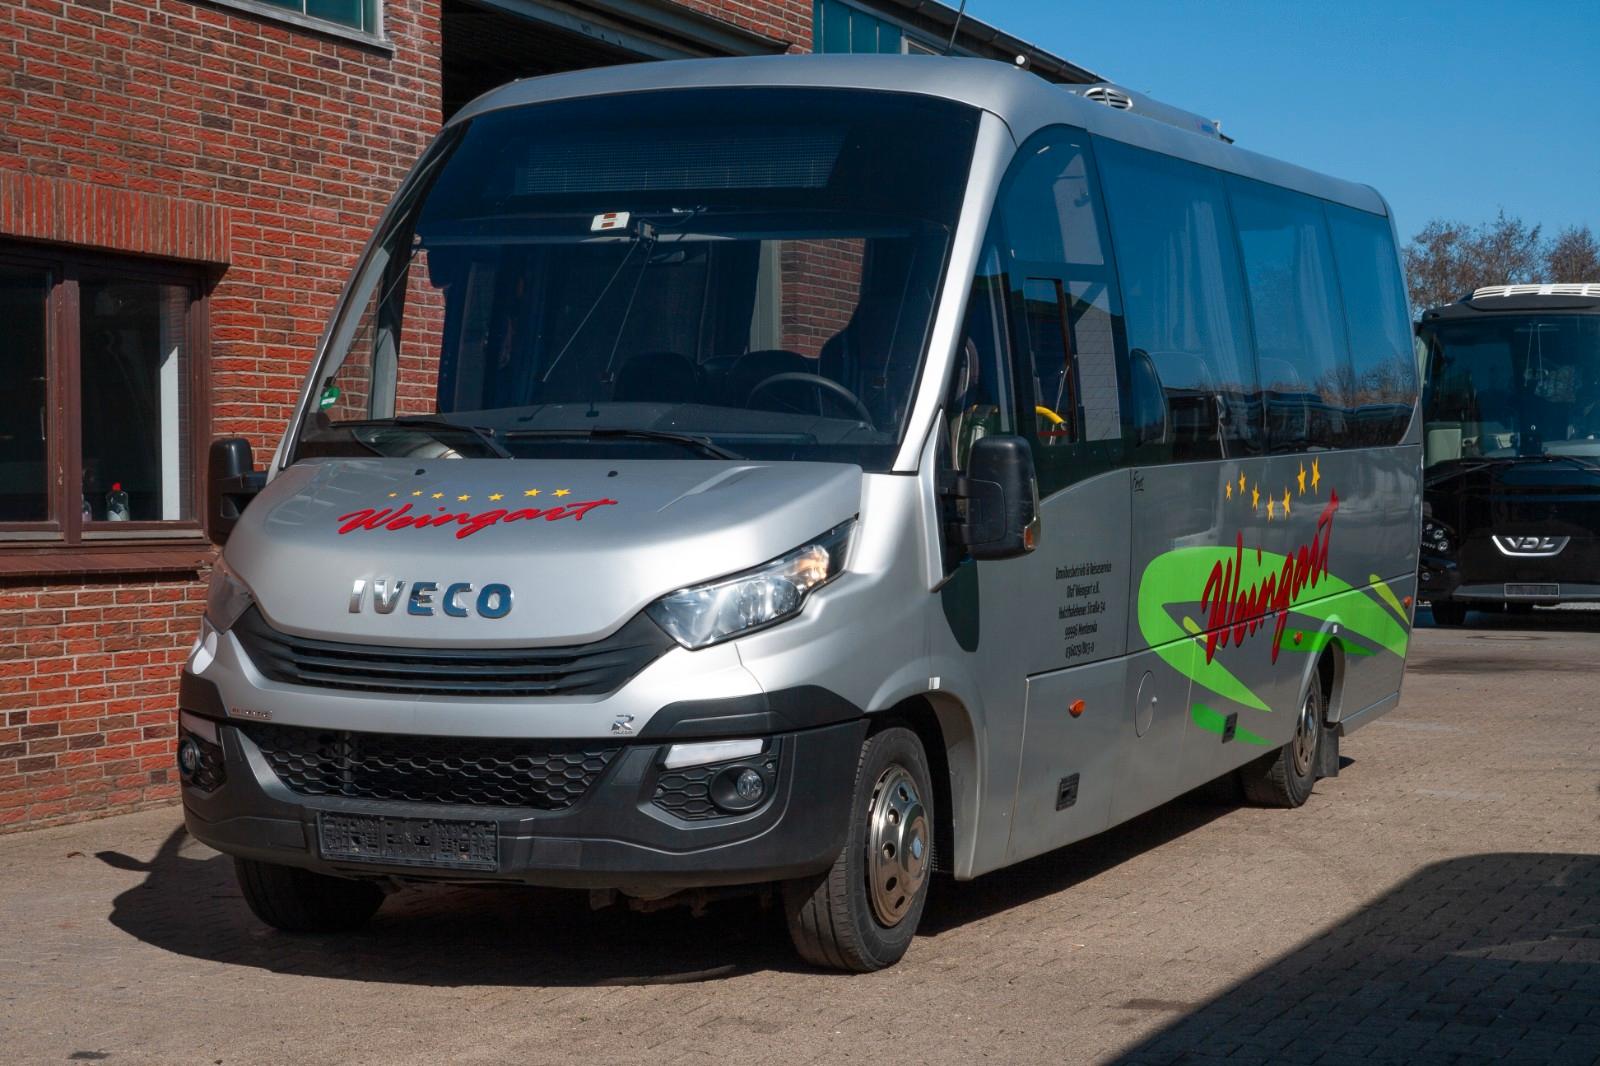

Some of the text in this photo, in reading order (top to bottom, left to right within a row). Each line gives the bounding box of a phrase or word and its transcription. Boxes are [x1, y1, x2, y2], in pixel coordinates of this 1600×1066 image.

[338, 498, 619, 540] Weingart
[1504, 536, 1556, 550] VDL
[1201, 487, 1340, 666] Weingart
[348, 578, 516, 620] IVECO
